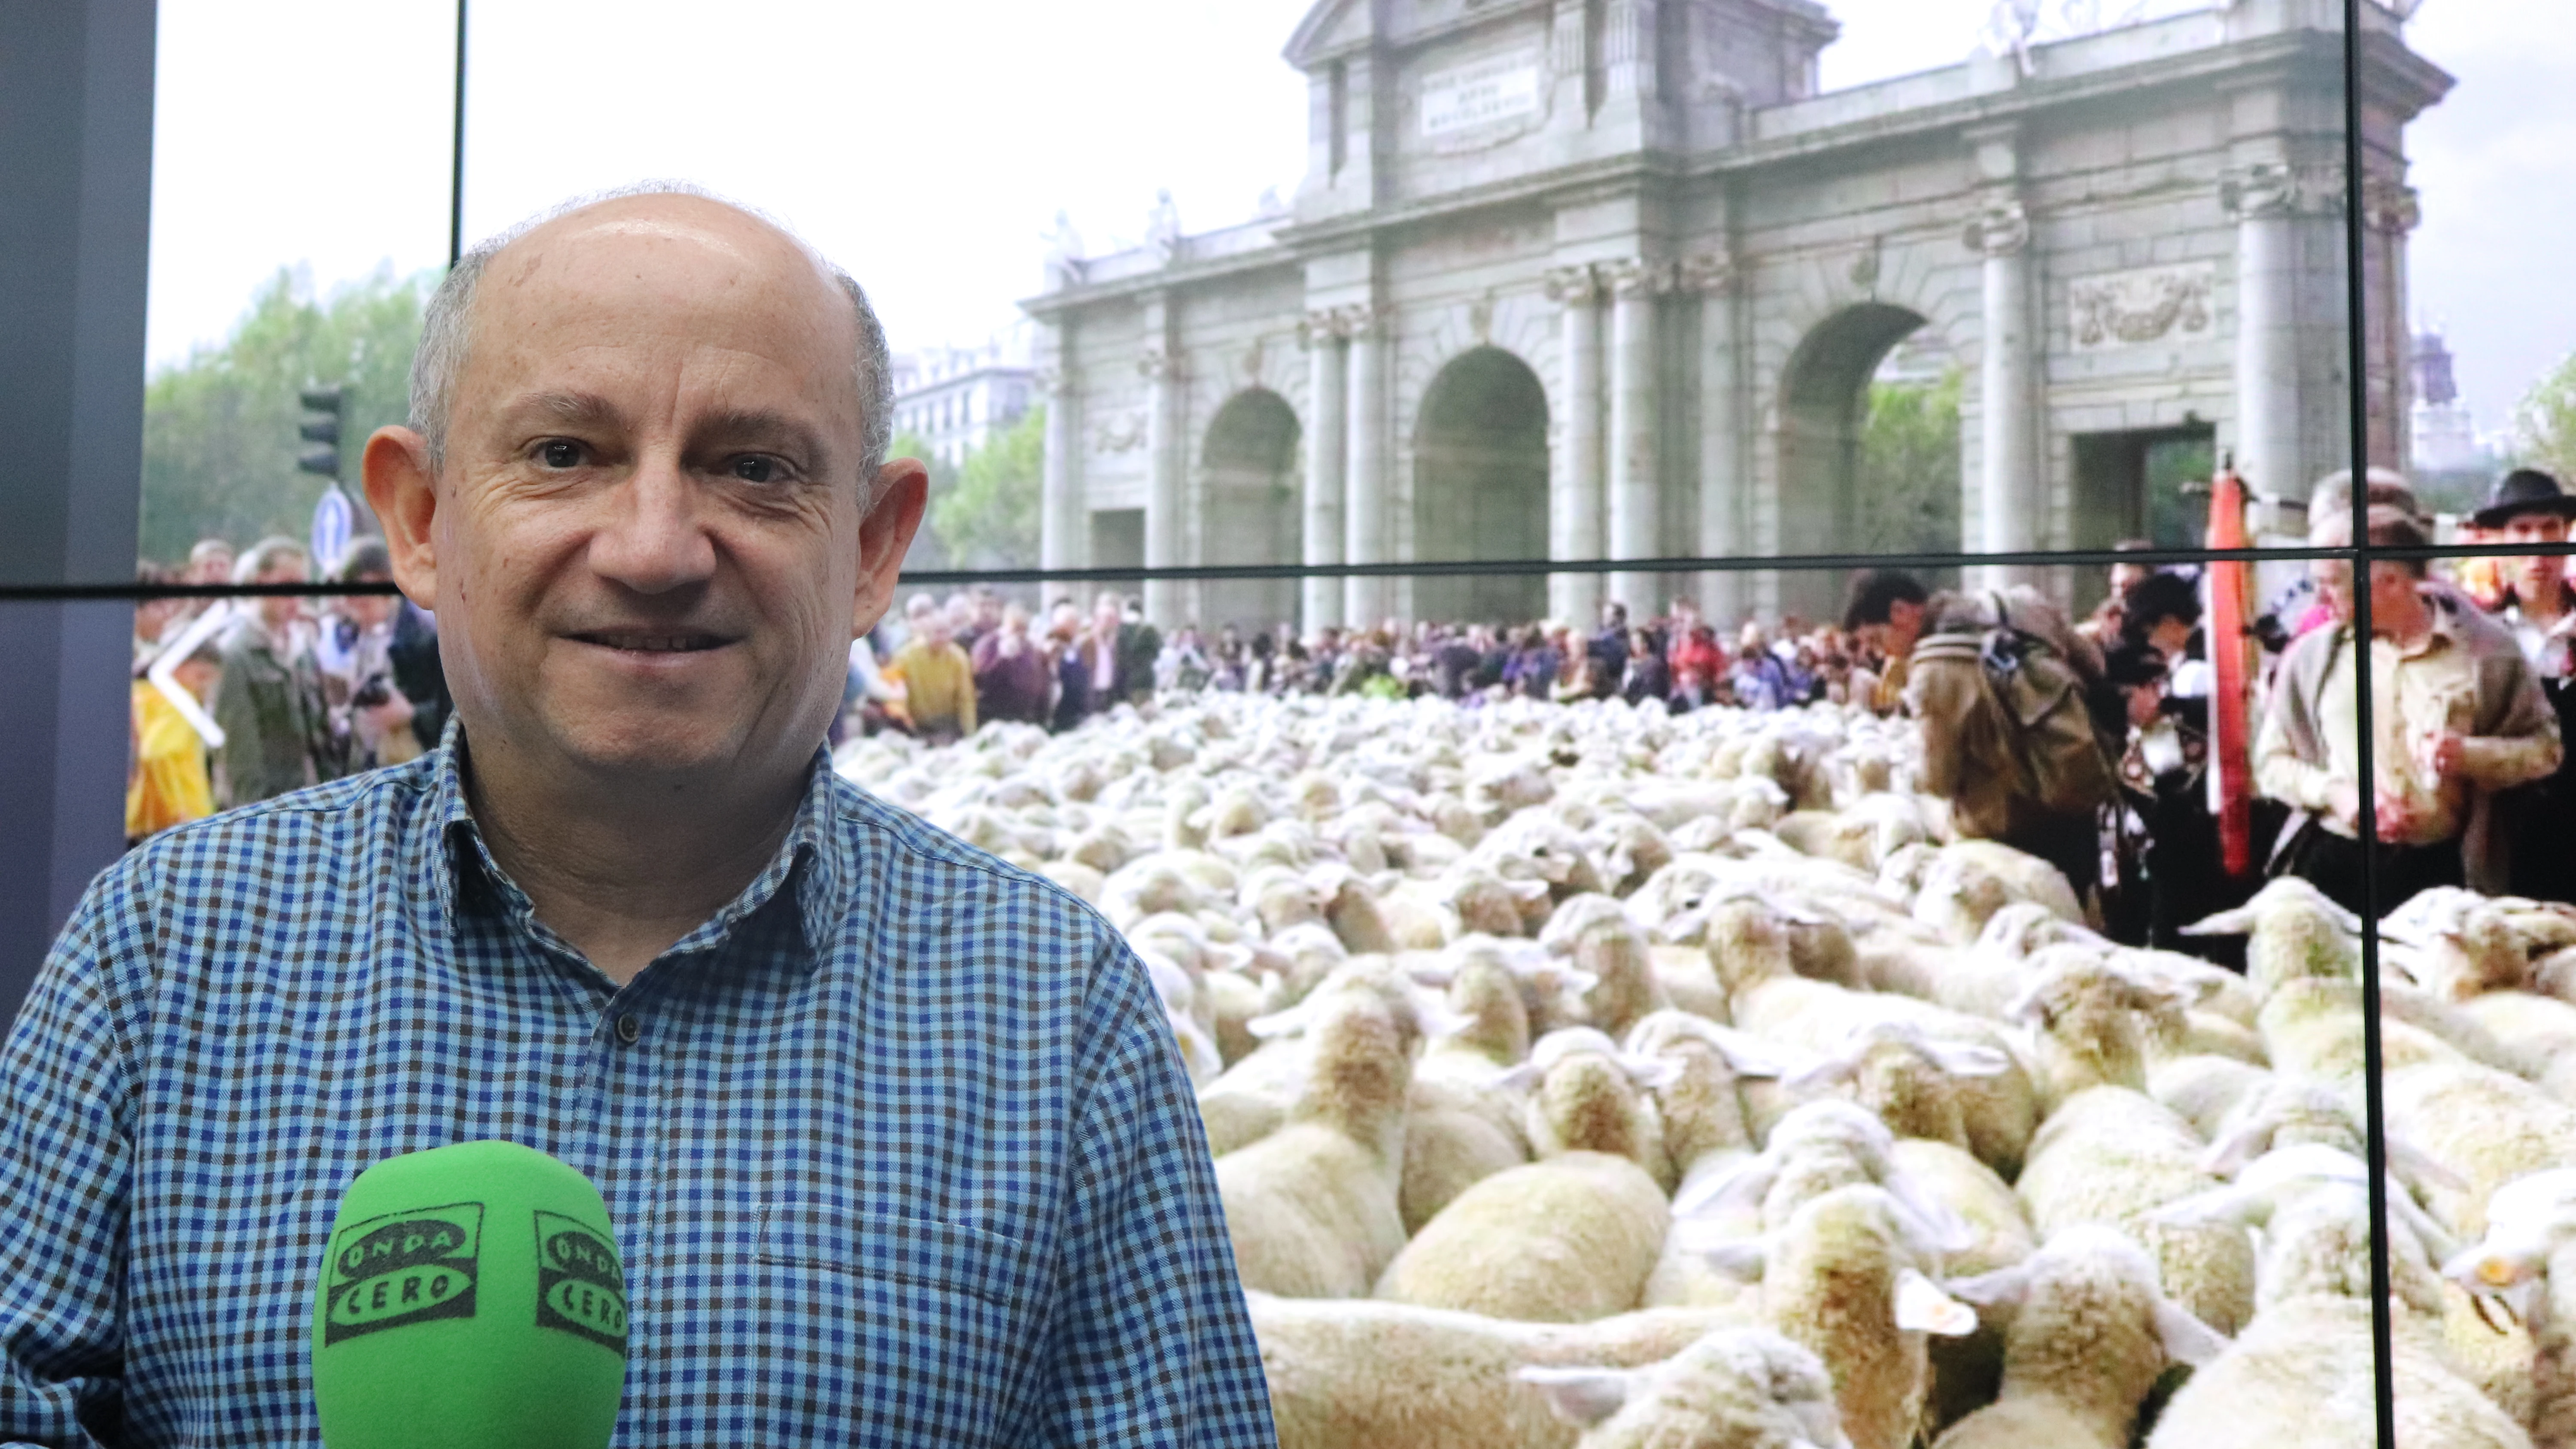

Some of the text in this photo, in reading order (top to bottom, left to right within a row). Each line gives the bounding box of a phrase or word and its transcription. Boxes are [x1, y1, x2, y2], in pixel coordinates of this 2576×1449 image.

[348, 1230, 451, 1267] ONDA
[556, 1237, 620, 1281] ONDA
[348, 1275, 449, 1315] CERO
[563, 1284, 622, 1329] CERO
